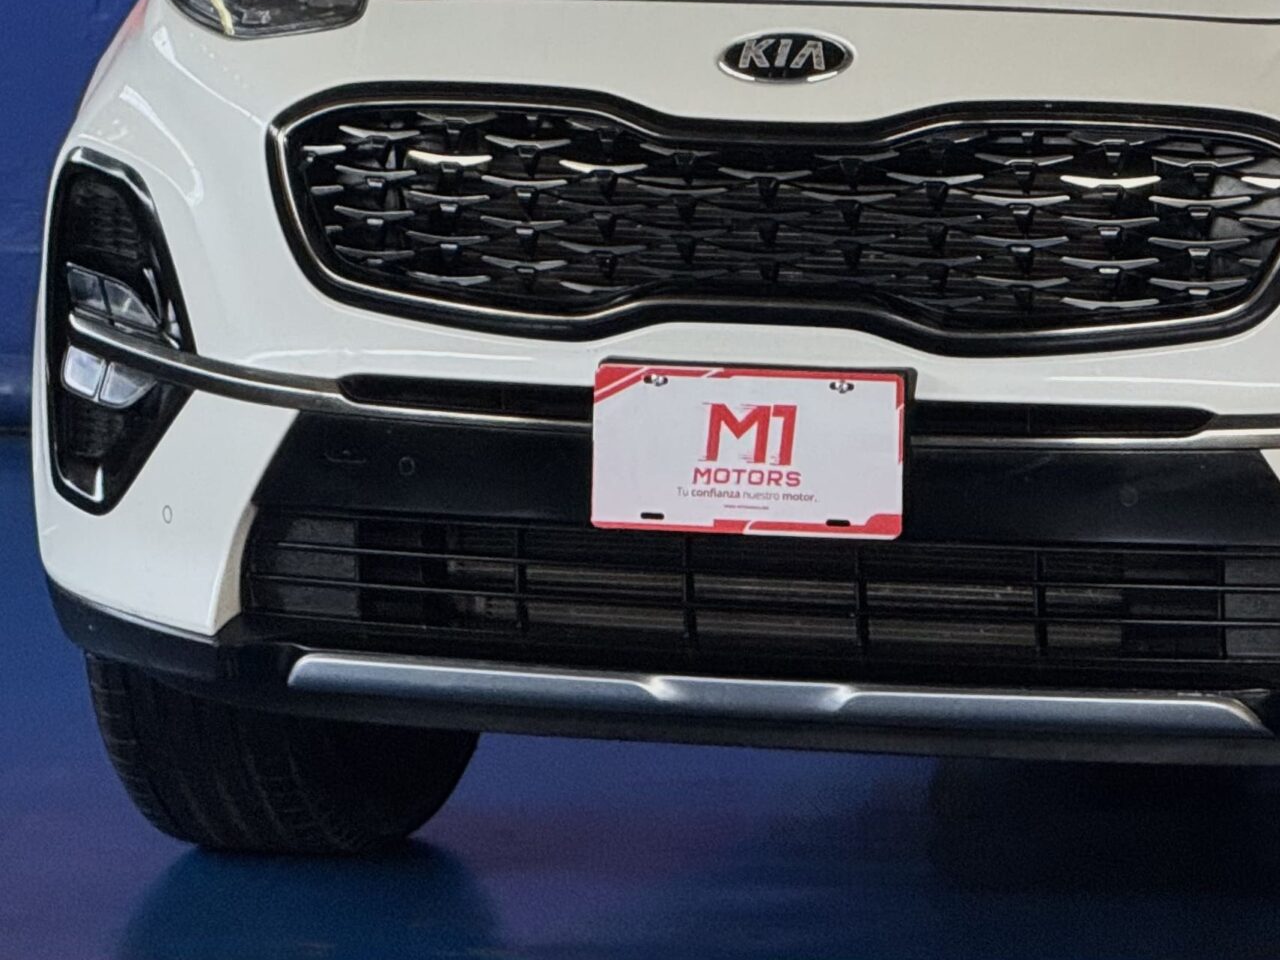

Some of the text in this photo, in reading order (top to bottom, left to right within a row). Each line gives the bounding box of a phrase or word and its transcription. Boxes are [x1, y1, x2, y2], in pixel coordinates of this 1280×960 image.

[738, 38, 826, 71] KIA
[692, 467, 802, 487] MOTORS
[677, 487, 817, 503] Tu confianza nuestro motor.
